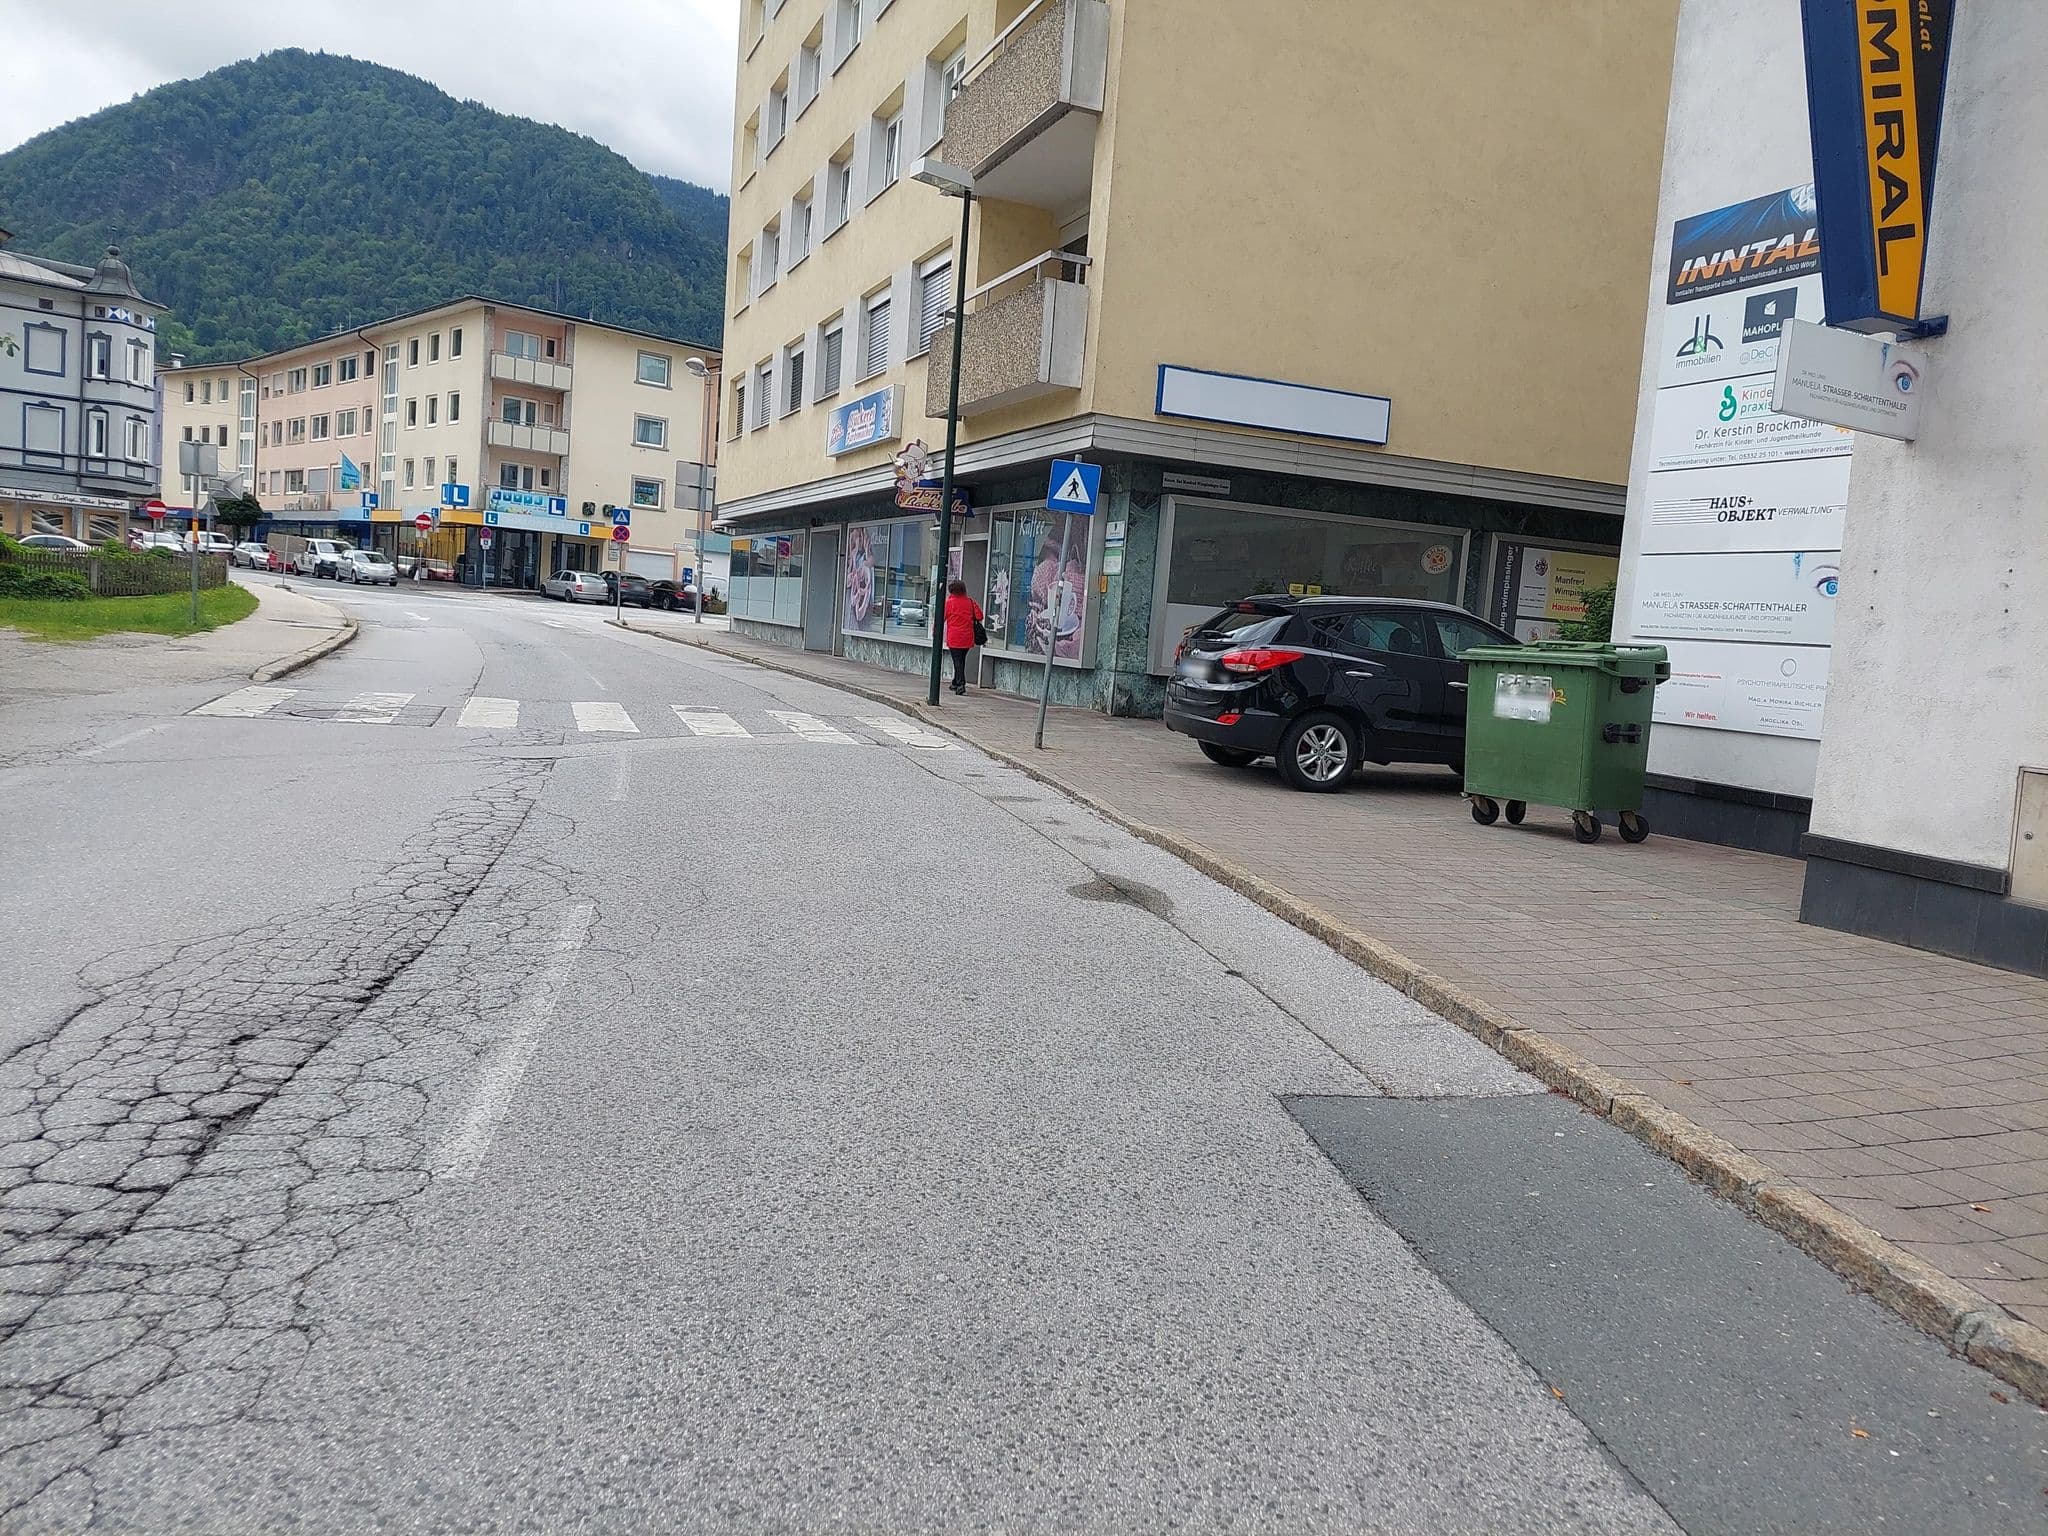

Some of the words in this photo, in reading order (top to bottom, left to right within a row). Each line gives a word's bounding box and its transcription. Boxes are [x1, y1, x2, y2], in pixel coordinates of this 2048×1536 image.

[1866, 0, 1915, 276] MIRAL
[1676, 227, 1820, 286] INNTAL
[1675, 353, 1722, 369] immobilien
[1792, 378, 1821, 390] MANUELA
[1822, 384, 1908, 412] STRASSER-SCHRATTENTHALER
[1695, 429, 1710, 440] Dr.
[1713, 424, 1753, 438] Kerstin
[1756, 436, 1768, 444] und
[453, 487, 464, 503] L
[551, 499, 563, 514] L
[1717, 508, 1777, 523] OBJEKT
[1778, 505, 1833, 516] VERWALTUNG
[1019, 512, 1045, 537] Kaffee
[1554, 575, 1585, 585] Manfred
[1642, 600, 1678, 609] MANUELA
[1679, 601, 1808, 613] STRASSER-SCHRATTENTHALER
[1737, 678, 1814, 691] PSYCHOTHERAPEUTISCHE
